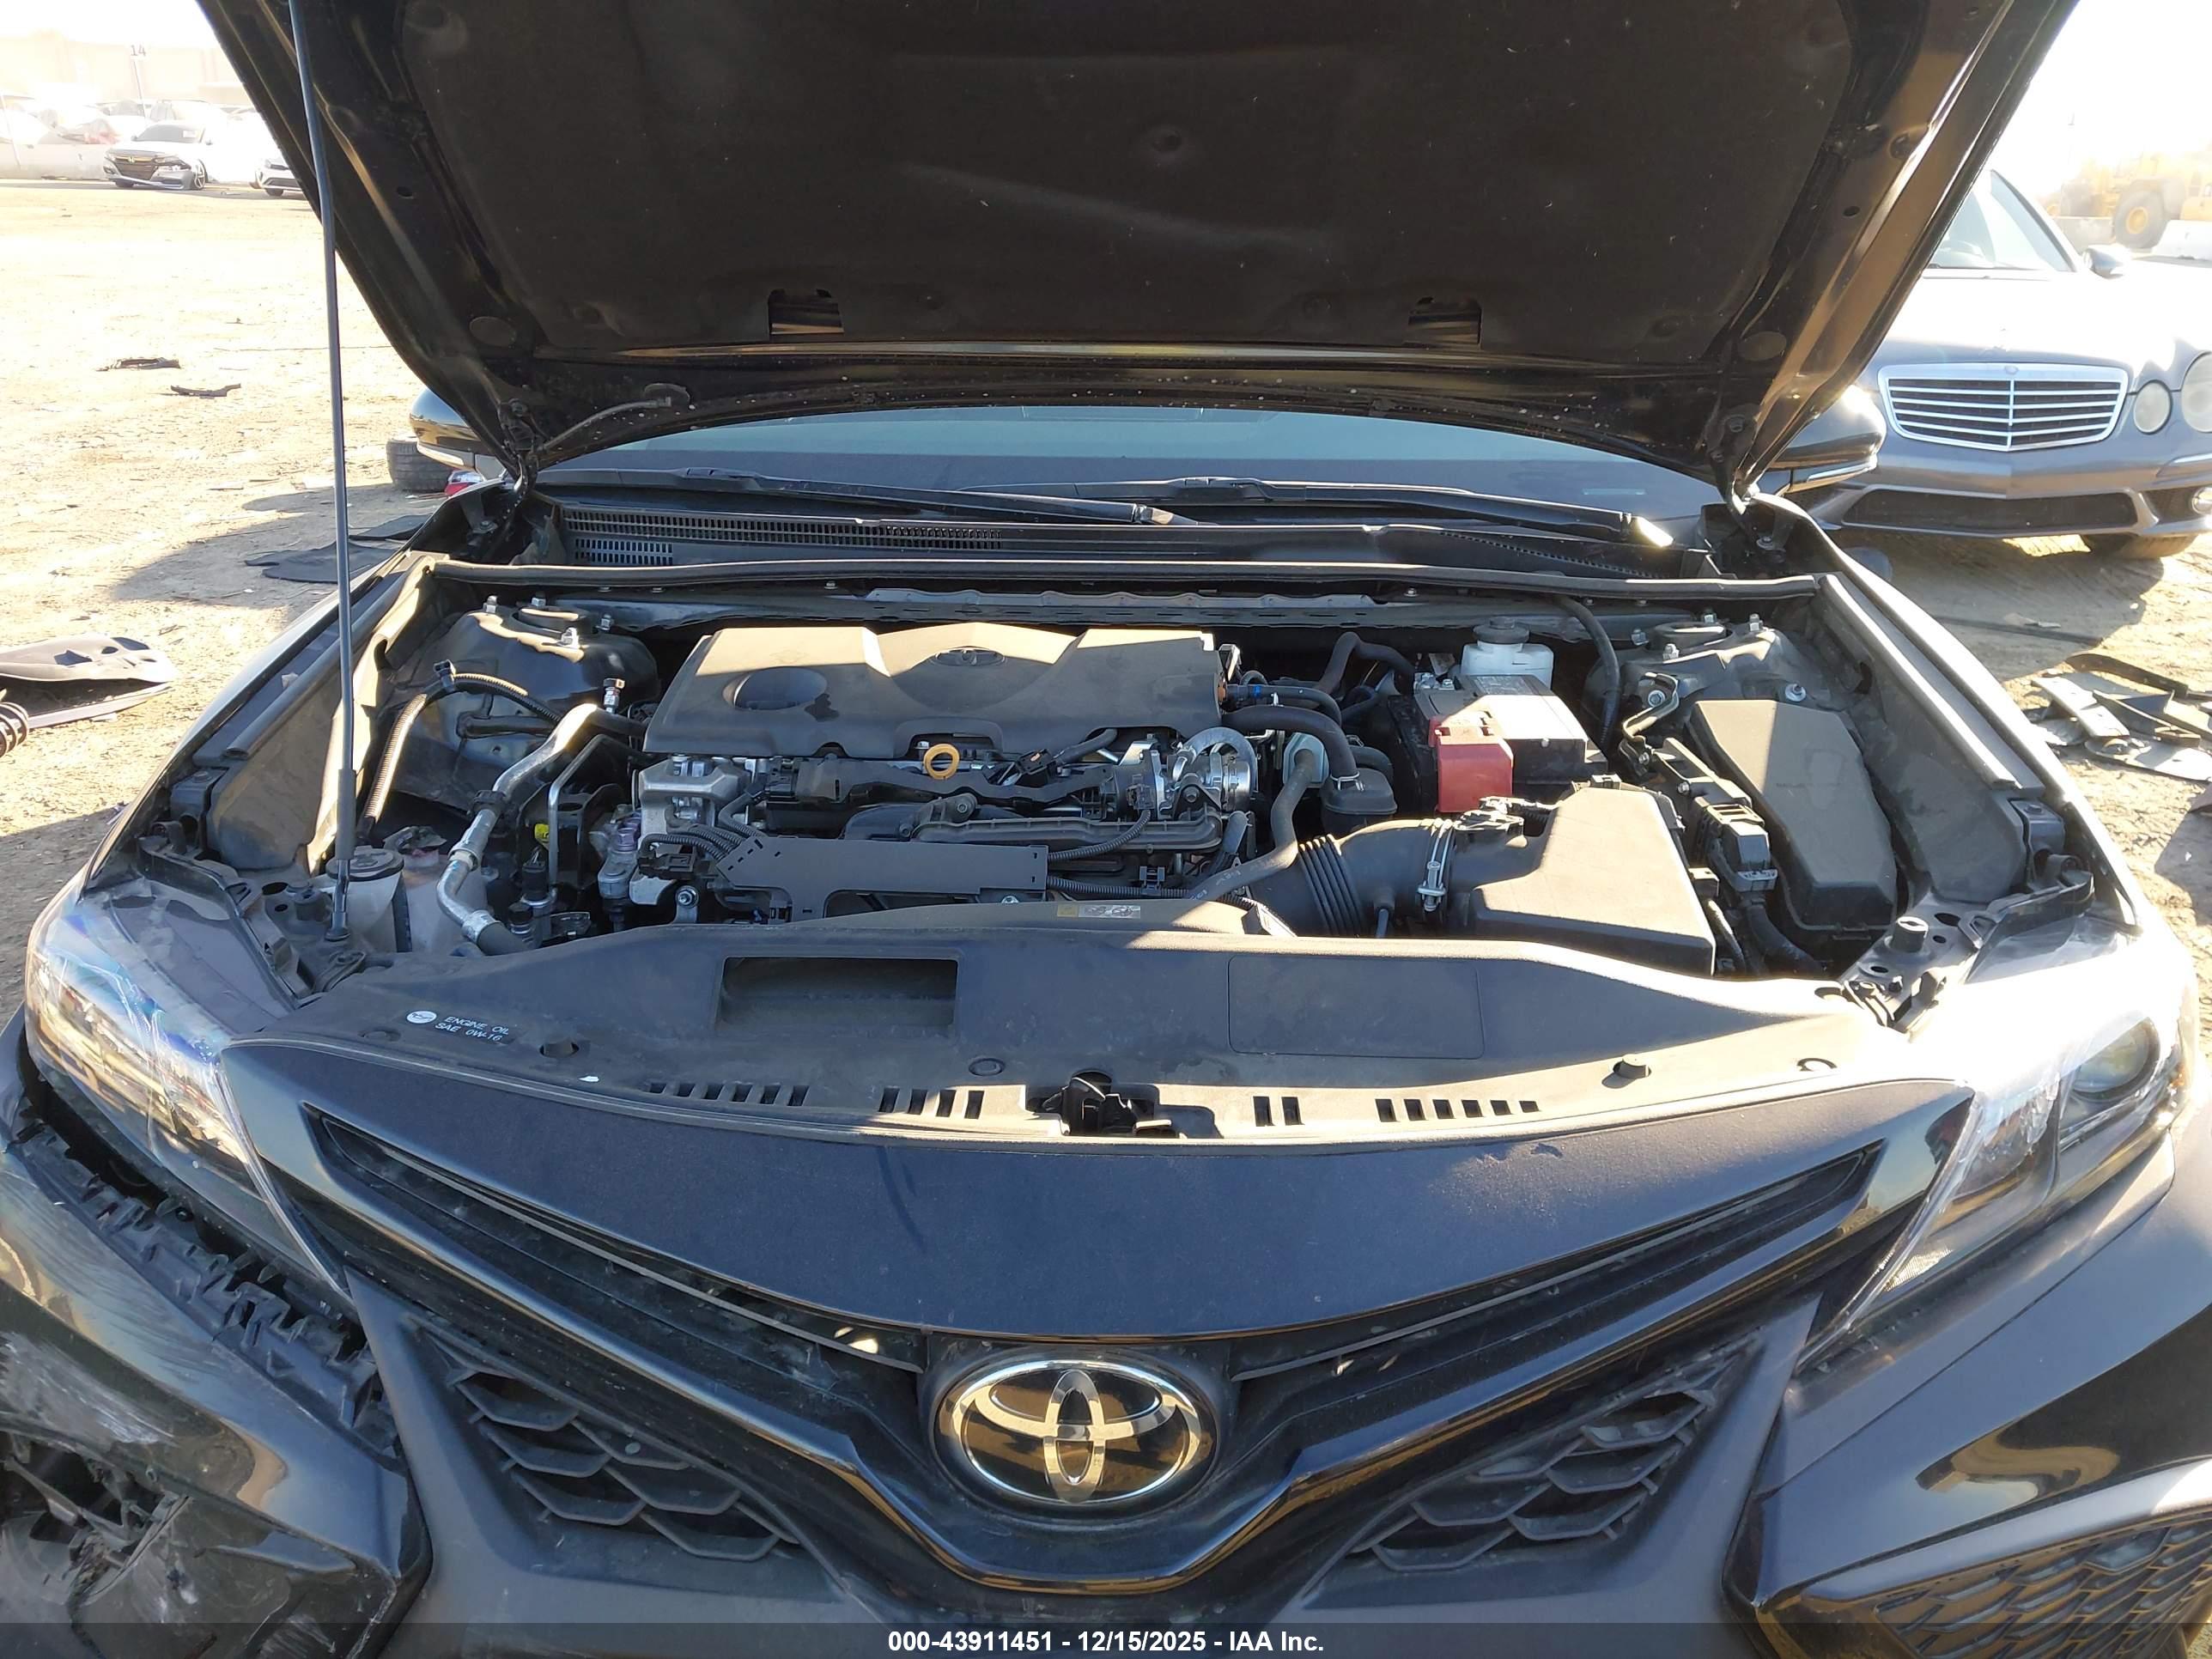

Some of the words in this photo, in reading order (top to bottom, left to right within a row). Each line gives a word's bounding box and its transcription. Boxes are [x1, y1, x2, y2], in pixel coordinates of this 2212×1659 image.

[131, 44, 146, 57] 14
[434, 1022, 462, 1032] SAE
[465, 1029, 503, 1042] 0W-16
[445, 1016, 488, 1030] ENGINE
[491, 1025, 509, 1035] OIL
